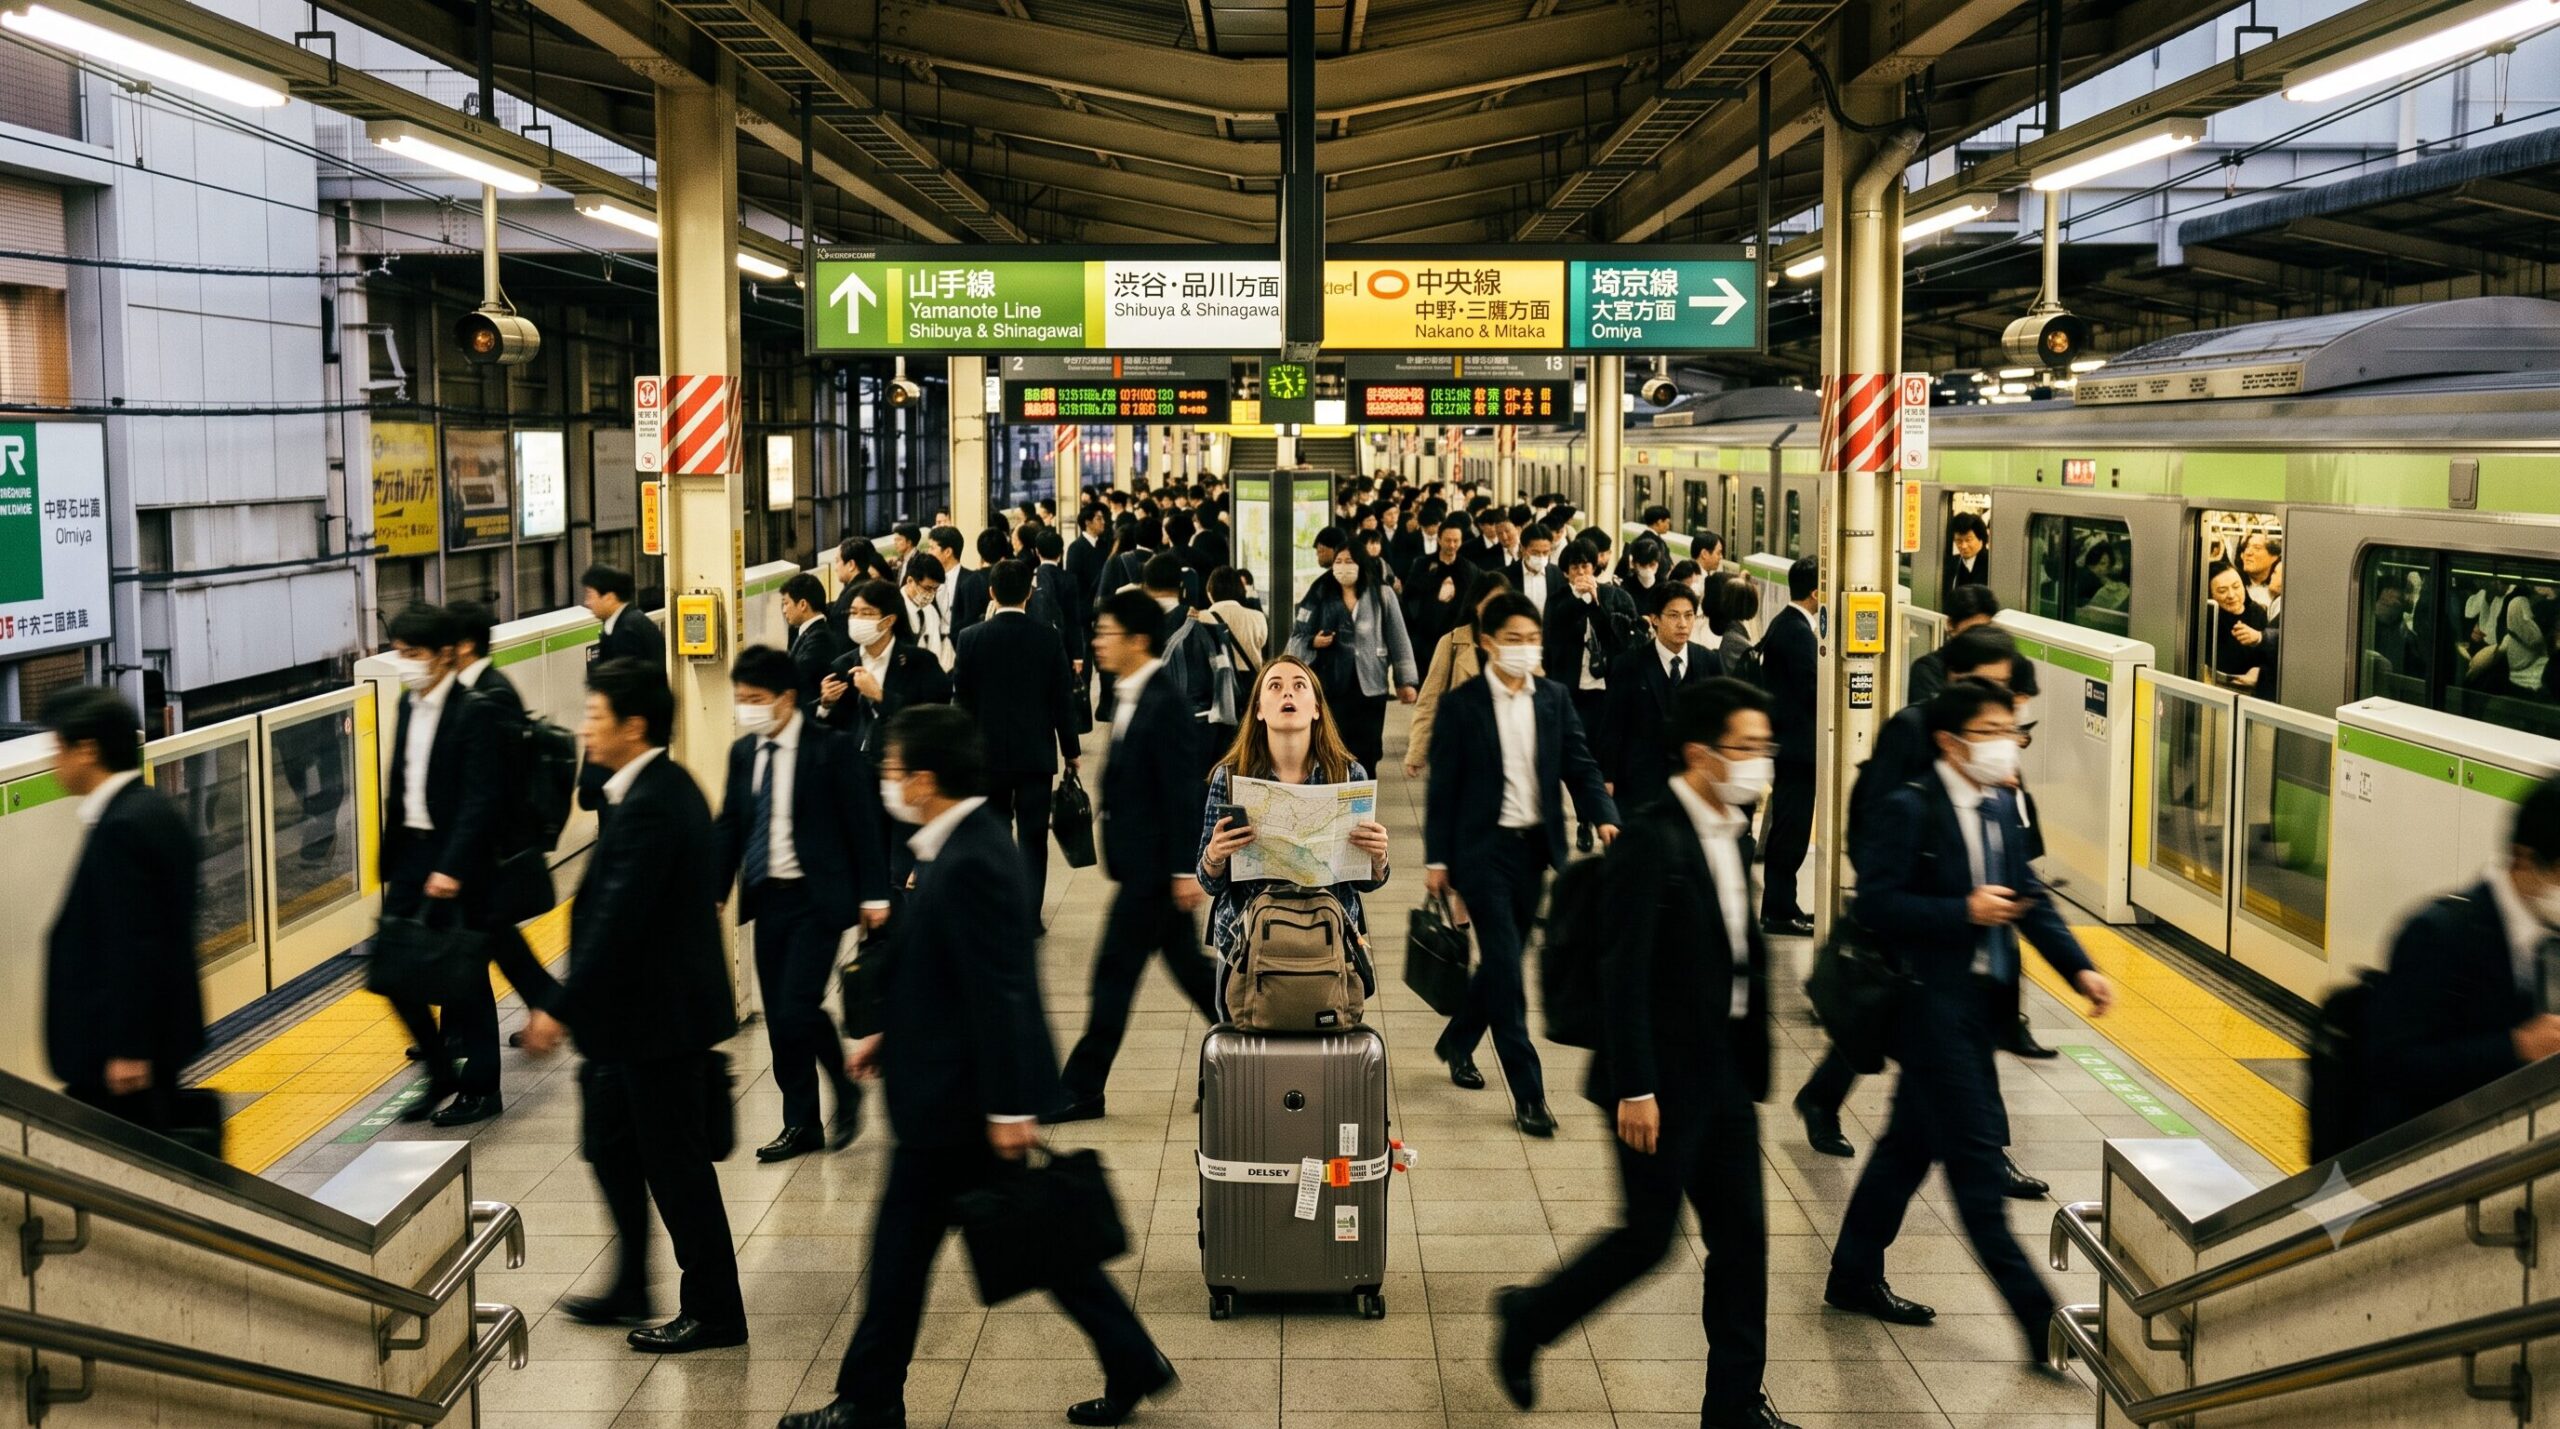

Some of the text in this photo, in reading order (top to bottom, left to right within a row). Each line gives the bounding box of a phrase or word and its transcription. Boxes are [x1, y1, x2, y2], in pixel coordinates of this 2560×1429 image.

[909, 269, 996, 299] 山手線
[1114, 271, 1279, 298] 渋谷・品川方面
[1417, 268, 1501, 296] 中央線
[1592, 268, 1679, 297] 埼京線
[909, 302, 1041, 319] Yamanote Line
[1114, 303, 1279, 320] Shibuya & Shinagawa
[1592, 299, 1676, 321] 大宮方面
[909, 323, 973, 341] Shibuya
[977, 323, 988, 338] &
[1415, 324, 1545, 338] Nakano & Mitaka
[1592, 323, 1642, 342] Omiya
[1012, 357, 1024, 371] 2
[1545, 357, 1563, 371] 13
[1248, 1168, 1290, 1177] DELSEY
